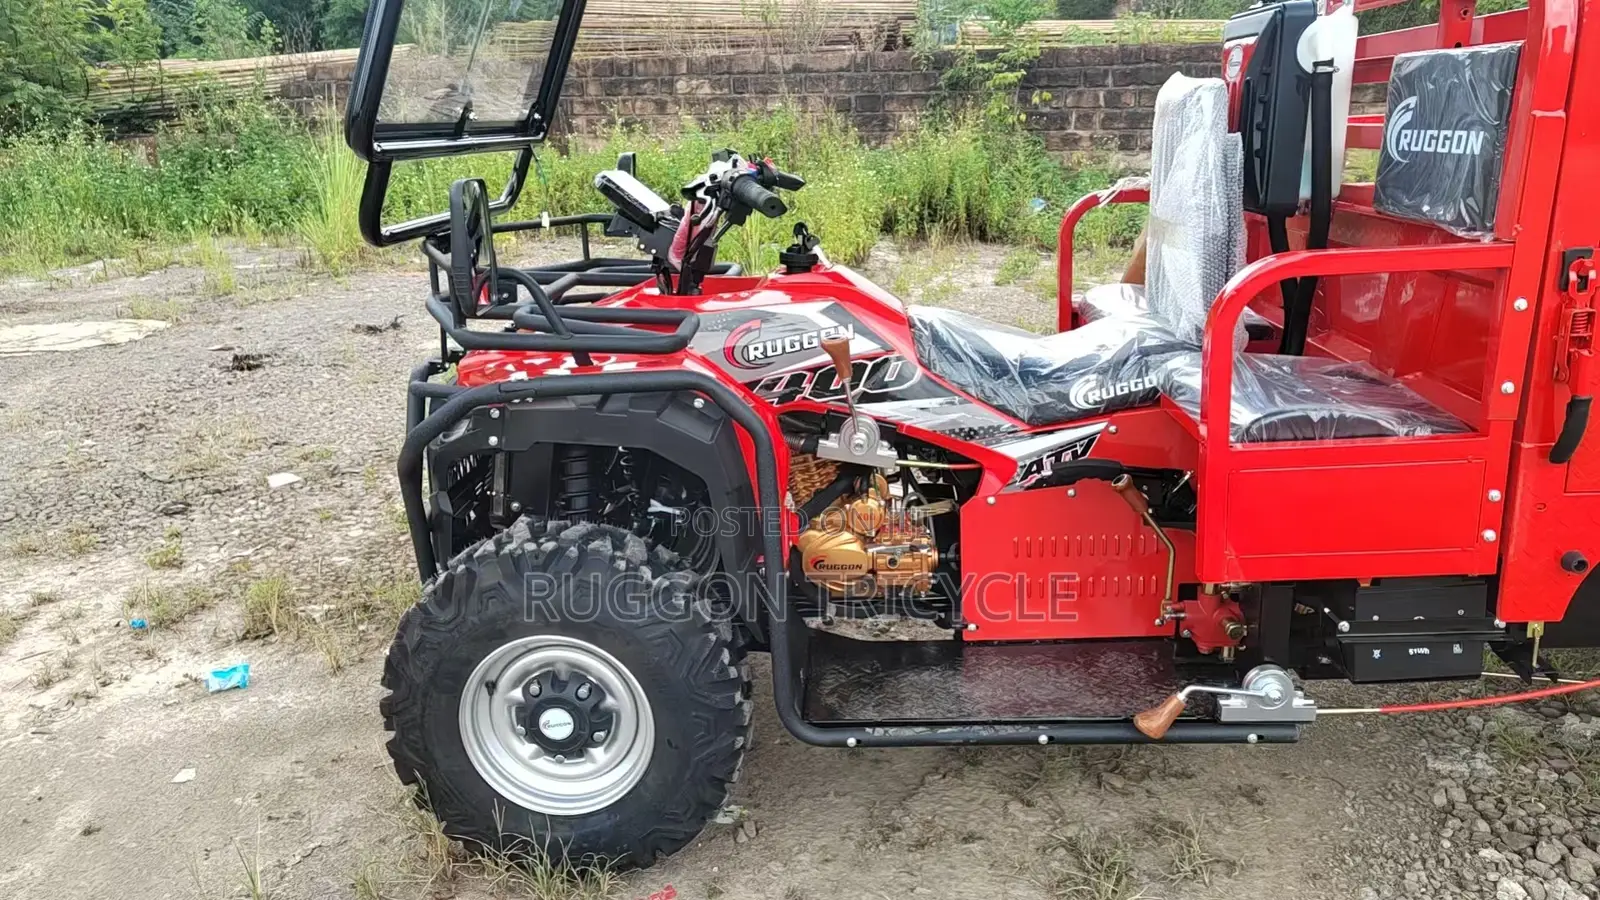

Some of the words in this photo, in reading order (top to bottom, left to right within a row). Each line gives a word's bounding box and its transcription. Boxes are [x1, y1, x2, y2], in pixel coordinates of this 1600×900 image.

[1398, 128, 1485, 156] RUGGON
[752, 353, 921, 406] 400
[1017, 433, 1101, 484] ATV
[818, 563, 863, 571] RUGGON
